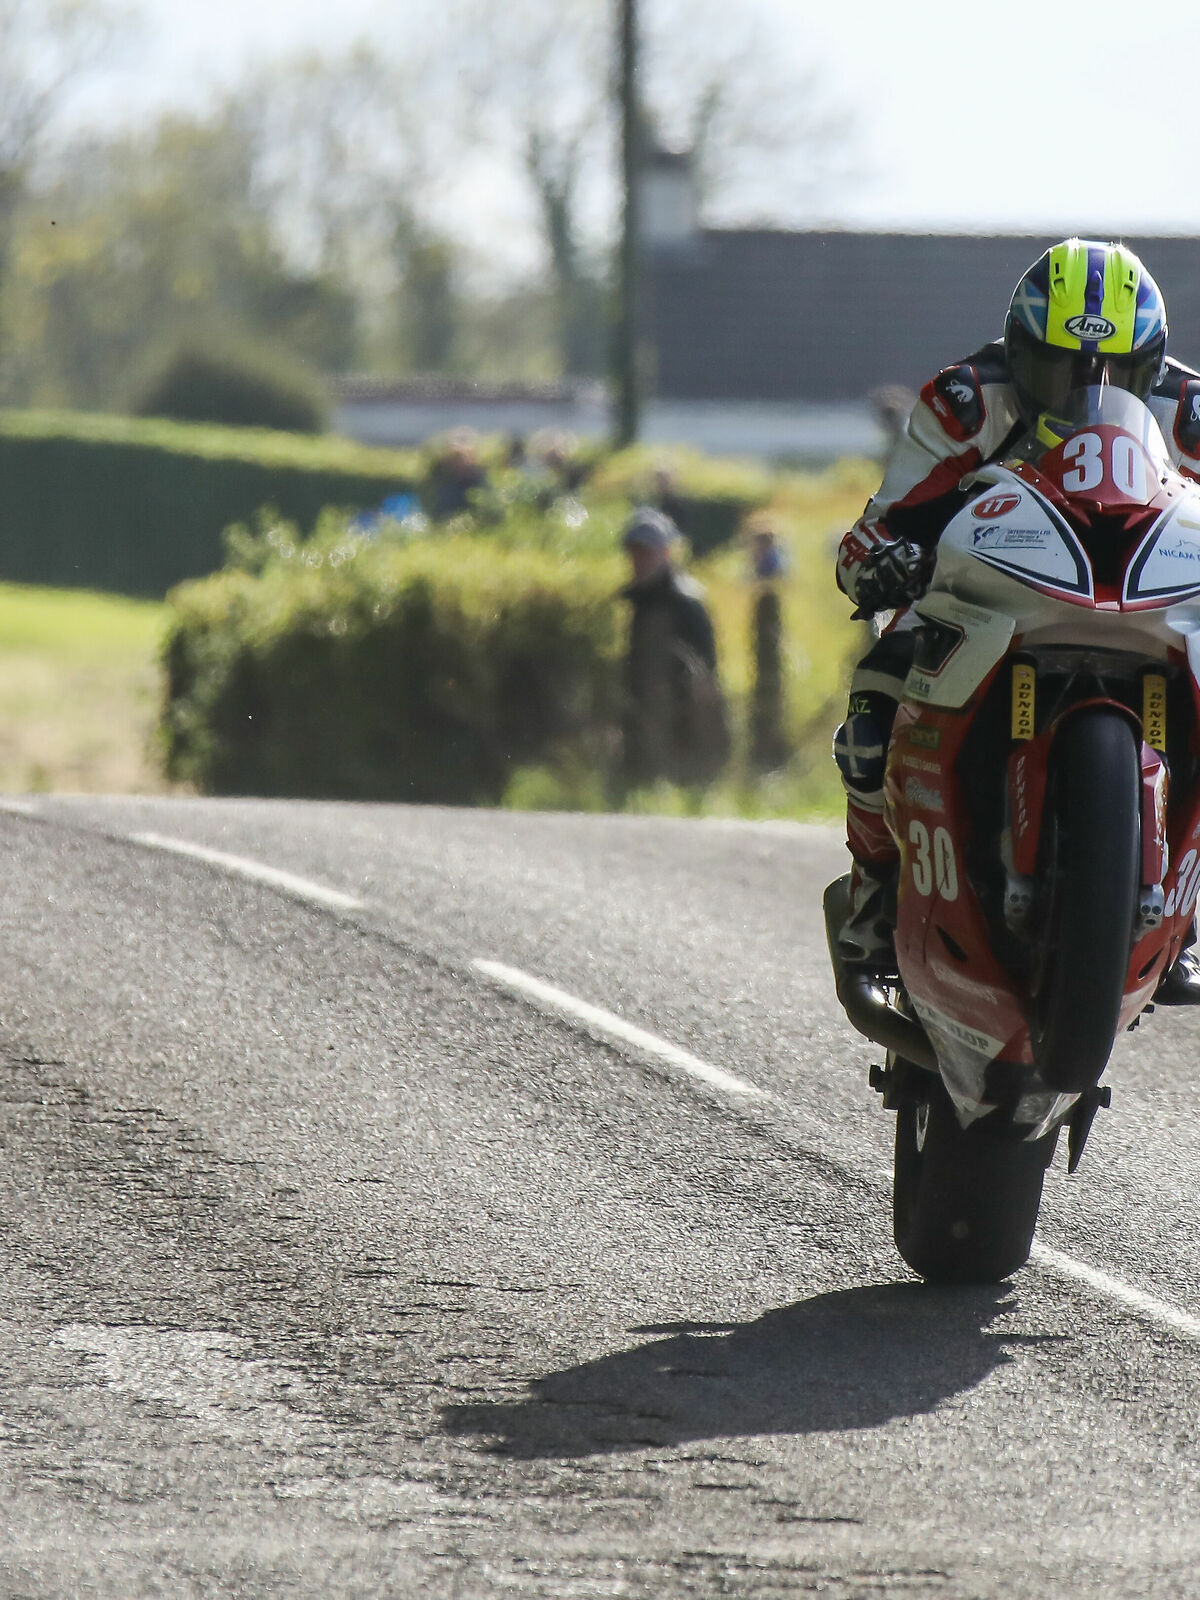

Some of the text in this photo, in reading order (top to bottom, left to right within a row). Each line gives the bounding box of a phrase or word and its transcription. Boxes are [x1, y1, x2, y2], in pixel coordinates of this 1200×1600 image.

[1069, 316, 1109, 334] Arai
[1063, 432, 1147, 501] 30
[1159, 548, 1196, 562] NICAM
[1018, 683, 1031, 735] DUNLOP
[1150, 692, 1162, 745] DUNLOP
[909, 820, 958, 901] 30
